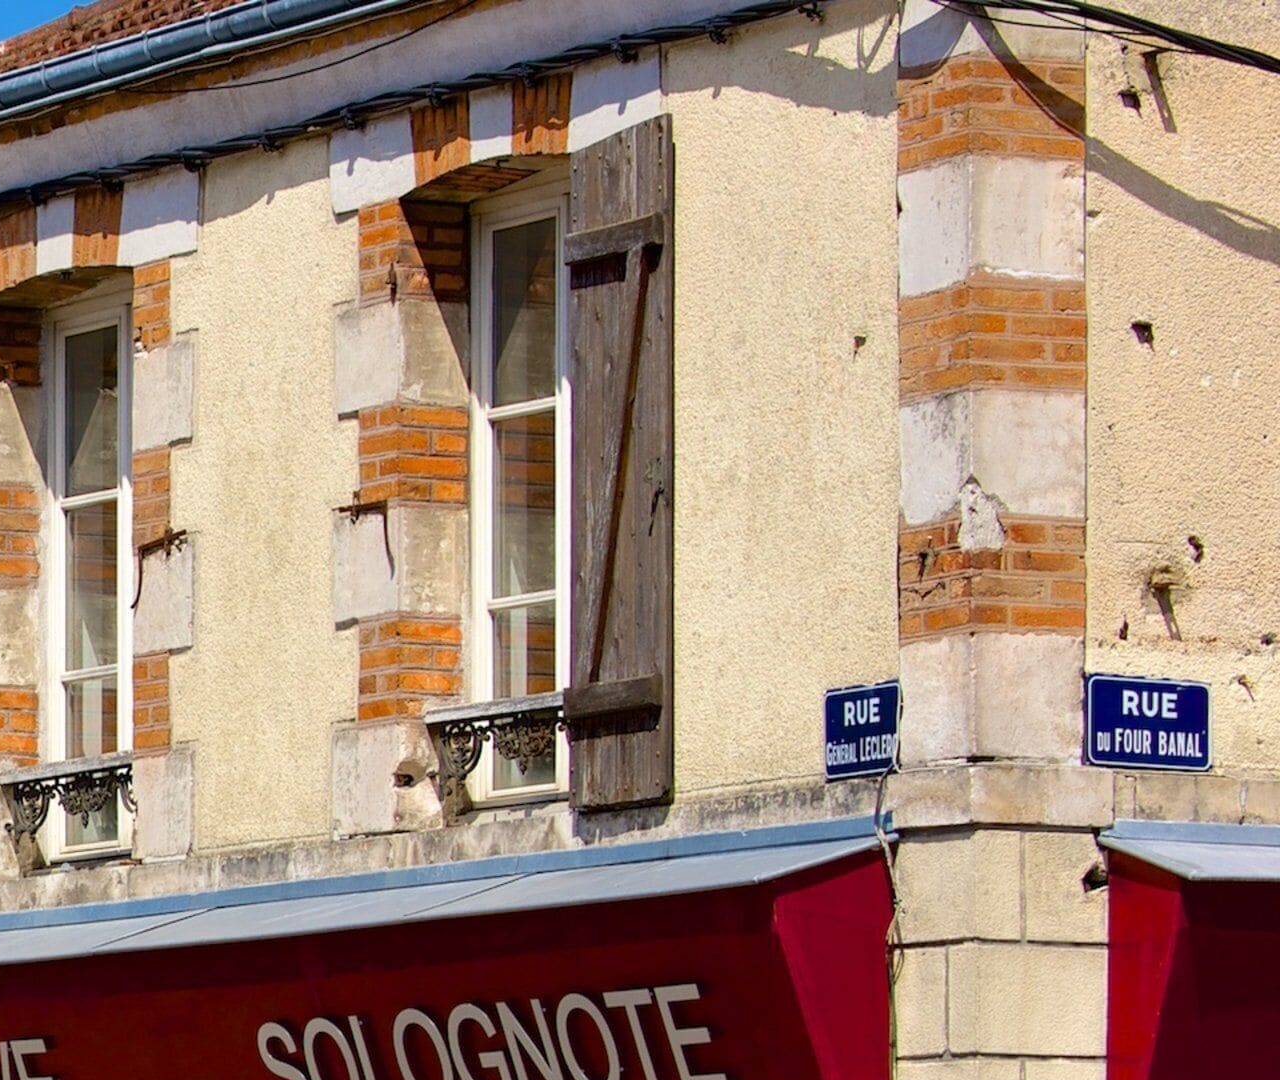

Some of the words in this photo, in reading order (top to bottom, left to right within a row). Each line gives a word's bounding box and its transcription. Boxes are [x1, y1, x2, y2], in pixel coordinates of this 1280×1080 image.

[844, 697, 881, 727] RUE
[1122, 690, 1178, 719] RUE
[1097, 732, 1111, 752] DU
[1115, 727, 1151, 755] FOUR
[1159, 731, 1203, 758] BANAL
